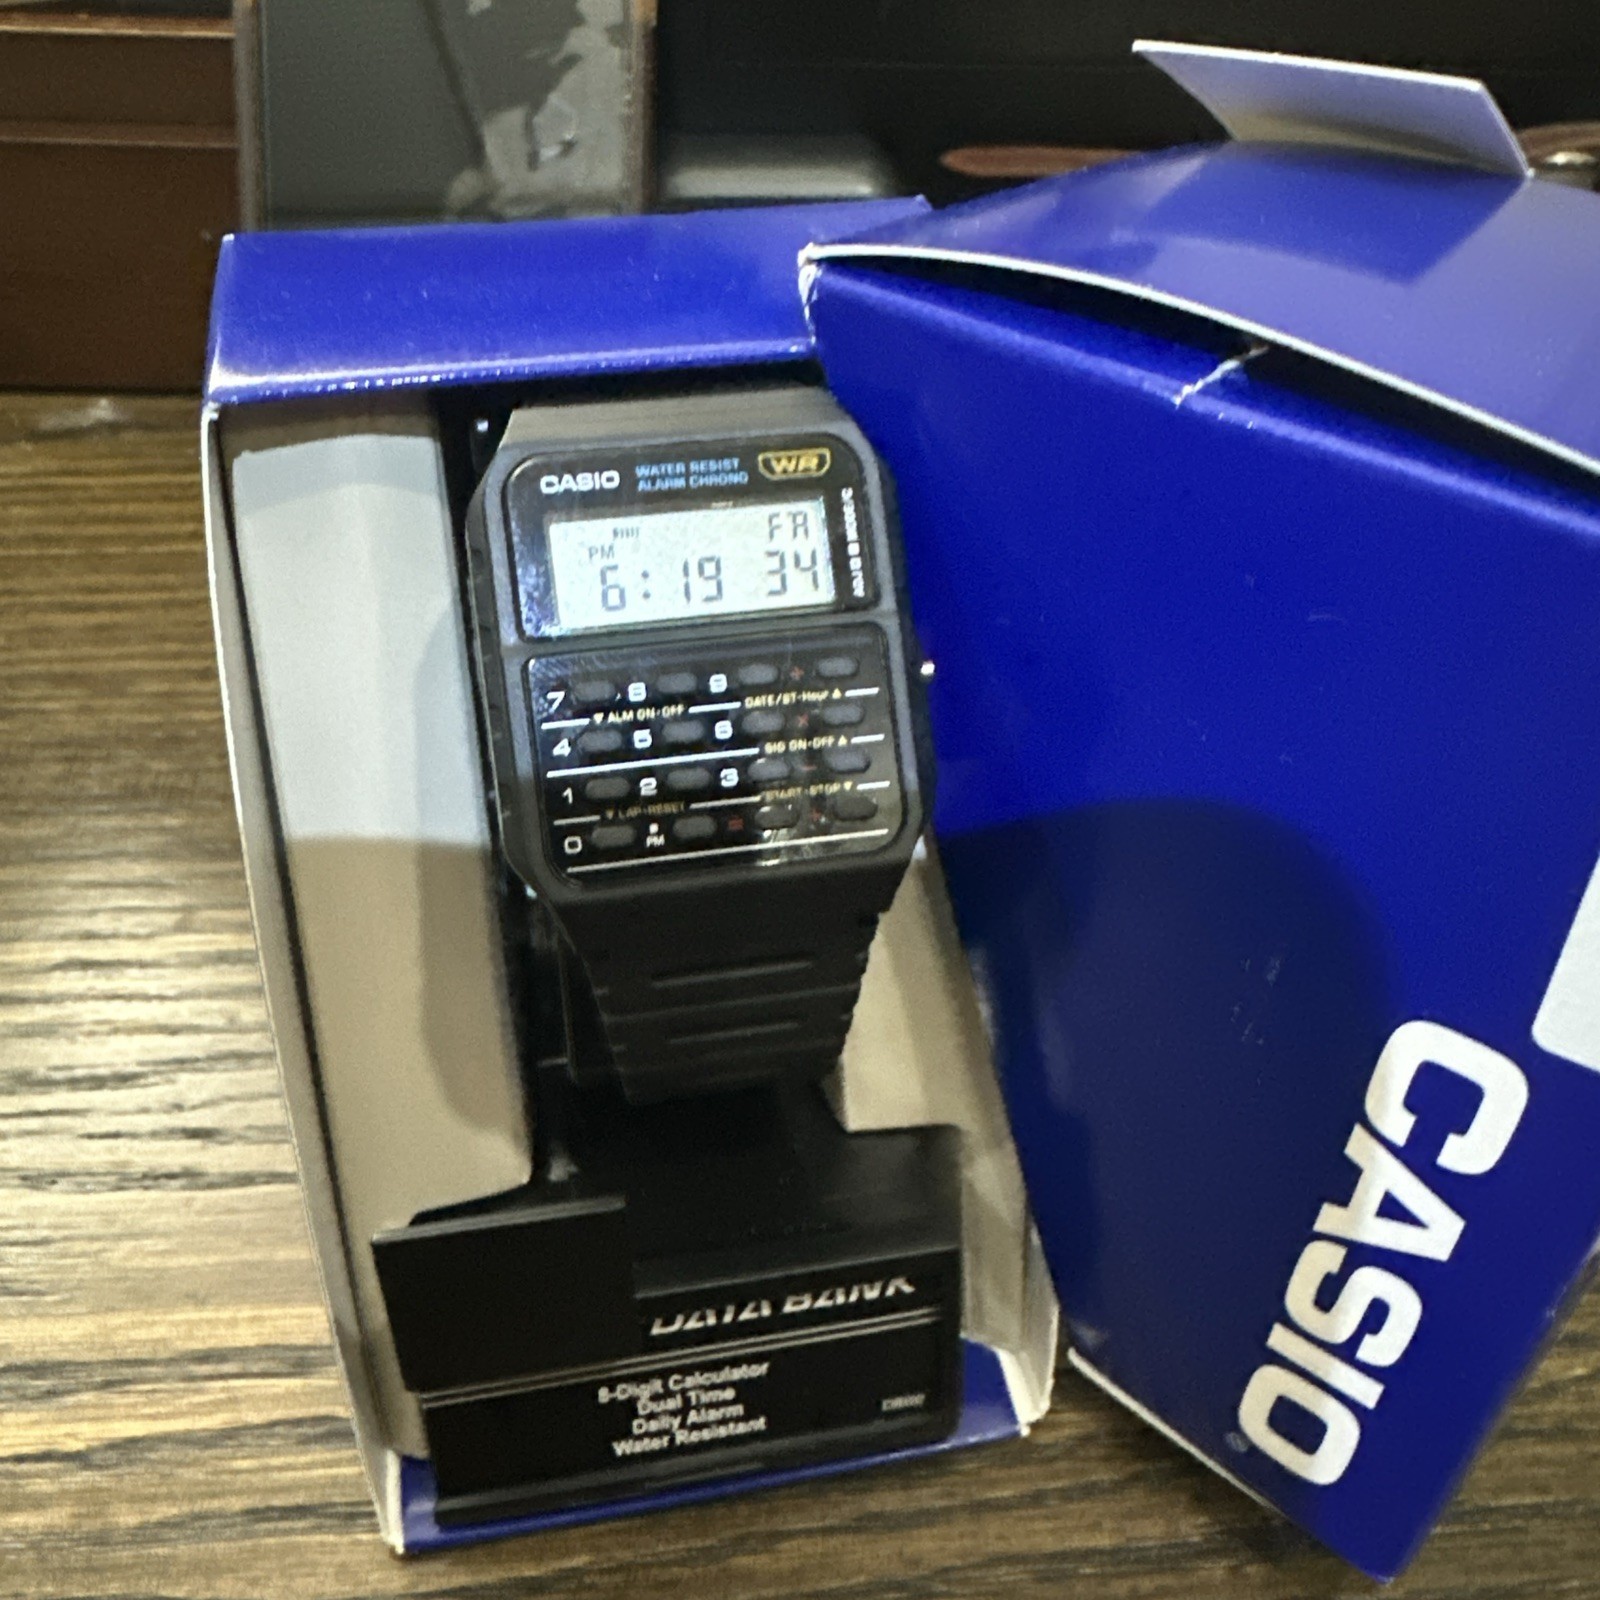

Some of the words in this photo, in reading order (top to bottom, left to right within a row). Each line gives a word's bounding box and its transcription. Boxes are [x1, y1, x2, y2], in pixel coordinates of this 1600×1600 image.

[636, 462, 686, 477] WATER
[690, 458, 740, 473] RESIST
[771, 455, 820, 474] WR
[540, 470, 621, 494] CASIO
[638, 476, 686, 492] ALARM
[689, 472, 749, 489] CHRONO
[588, 545, 616, 560] PM
[765, 549, 820, 598] 34
[546, 691, 566, 711] 7
[628, 682, 646, 702] 8
[607, 708, 634, 723] ALM
[552, 738, 571, 757] 4
[633, 729, 652, 749] 5
[562, 788, 573, 804] 1
[639, 777, 658, 796] 2
[720, 768, 739, 788] 3
[646, 834, 664, 848] PM
[1238, 1020, 1529, 1486] CASIO
[598, 1378, 664, 1404] 8-Digit
[668, 1362, 770, 1391] Calculator
[637, 1394, 682, 1416] Dual
[687, 1387, 736, 1406] Time
[632, 1415, 682, 1435] Daily
[686, 1403, 745, 1426] Alarm
[612, 1435, 671, 1457] Water
[674, 1415, 767, 1446] Resistant
